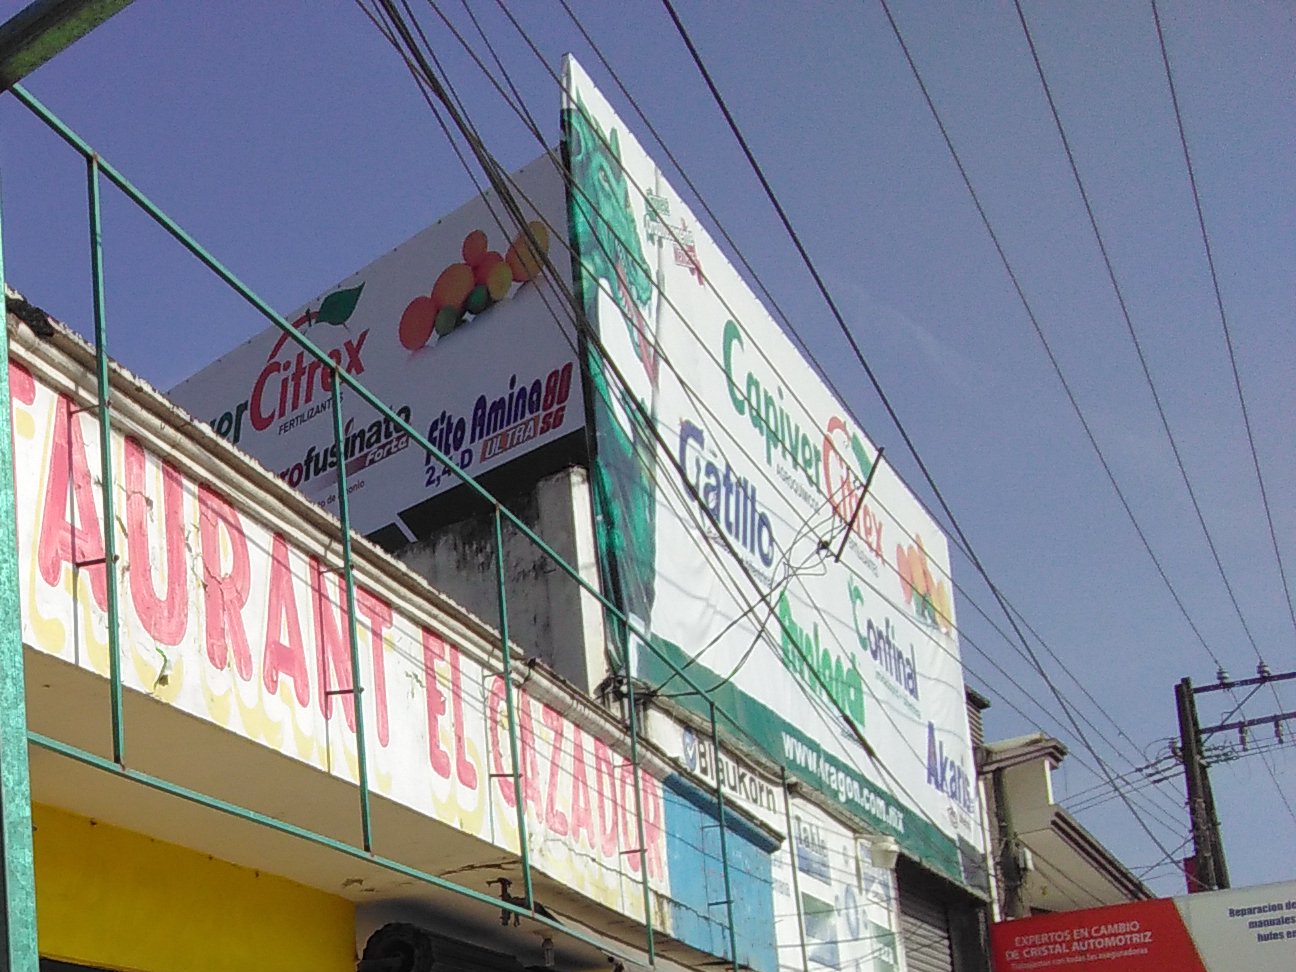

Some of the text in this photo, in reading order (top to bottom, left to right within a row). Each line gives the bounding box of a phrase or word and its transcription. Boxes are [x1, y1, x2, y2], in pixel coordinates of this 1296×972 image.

[249, 328, 369, 431] Citrex
[723, 319, 822, 494] Capiver
[278, 391, 344, 436] FERTILIZANTS
[425, 410, 466, 466] Fito
[470, 374, 542, 445] Amina
[483, 422, 536, 460] ULTRA
[679, 418, 774, 568] Gatillo
[421, 626, 478, 790] EL
[486, 674, 665, 882] CAZADOR
[698, 736, 777, 815] Blaukorn
[1015, 920, 1140, 947] EXPERTOS EN CAMBIO
[1229, 903, 1283, 918] Reparacion
[1248, 915, 1296, 929] manuales
[1005, 931, 1153, 960] DE CRISTAL AUTOMOTRIZ
